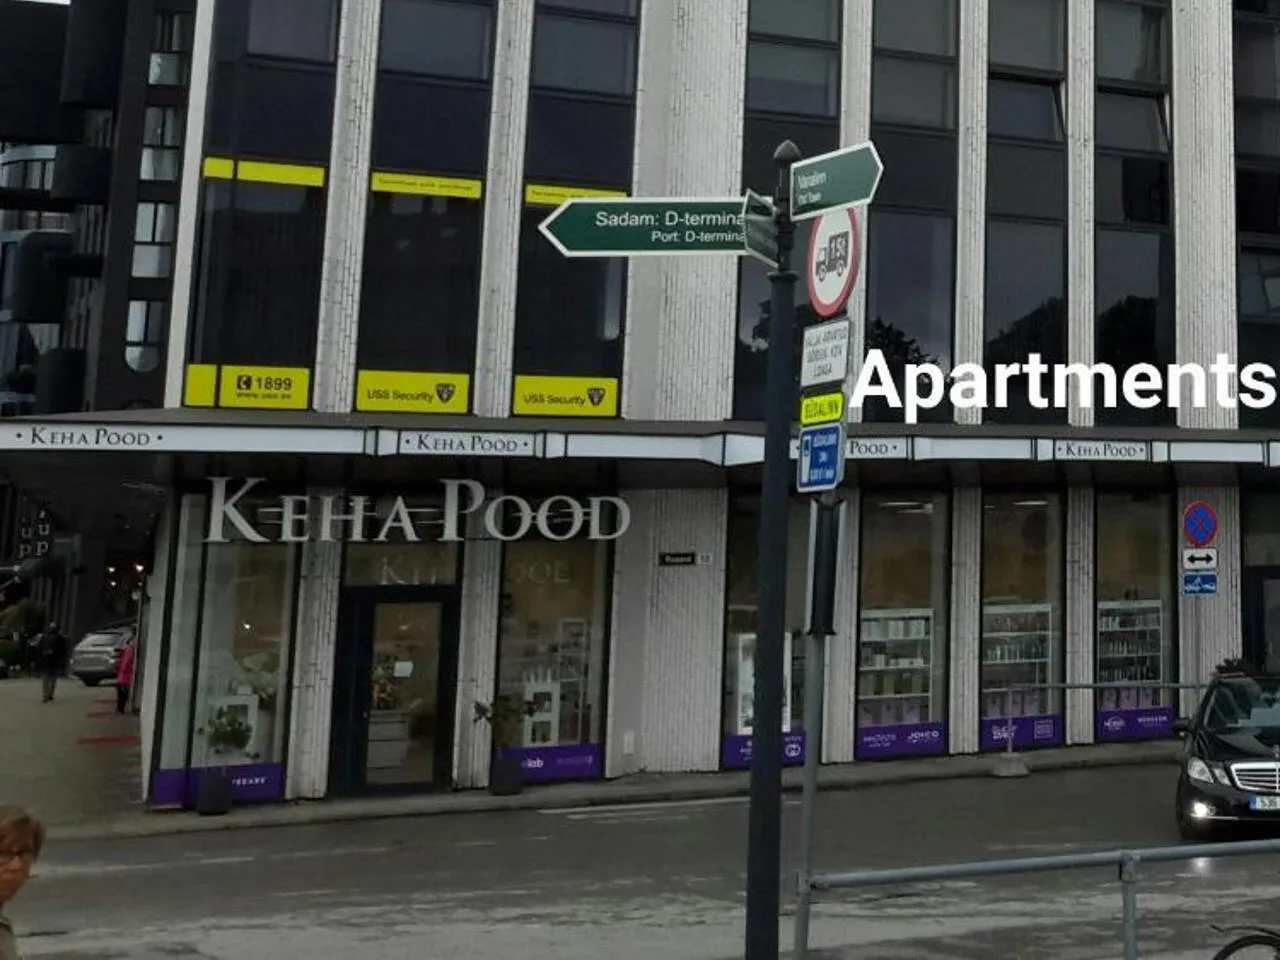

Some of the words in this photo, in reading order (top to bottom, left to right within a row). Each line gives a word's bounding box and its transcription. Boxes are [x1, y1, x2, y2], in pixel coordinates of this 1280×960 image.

[595, 211, 660, 227] Sadam:
[664, 210, 746, 227] D-termina
[684, 230, 746, 243] D-termina
[255, 376, 293, 391] 1899
[367, 388, 390, 400] USS
[392, 389, 435, 404] Security
[523, 394, 546, 405] USS
[547, 393, 586, 407] Security
[31, 426, 89, 445] KEHA
[94, 427, 151, 446] POOD
[417, 433, 466, 451] KEHA
[470, 435, 518, 452] POOD
[850, 440, 889, 455] POOD
[1104, 442, 1136, 457] POOD
[202, 476, 424, 543] KEHA
[436, 478, 632, 542] POOD
